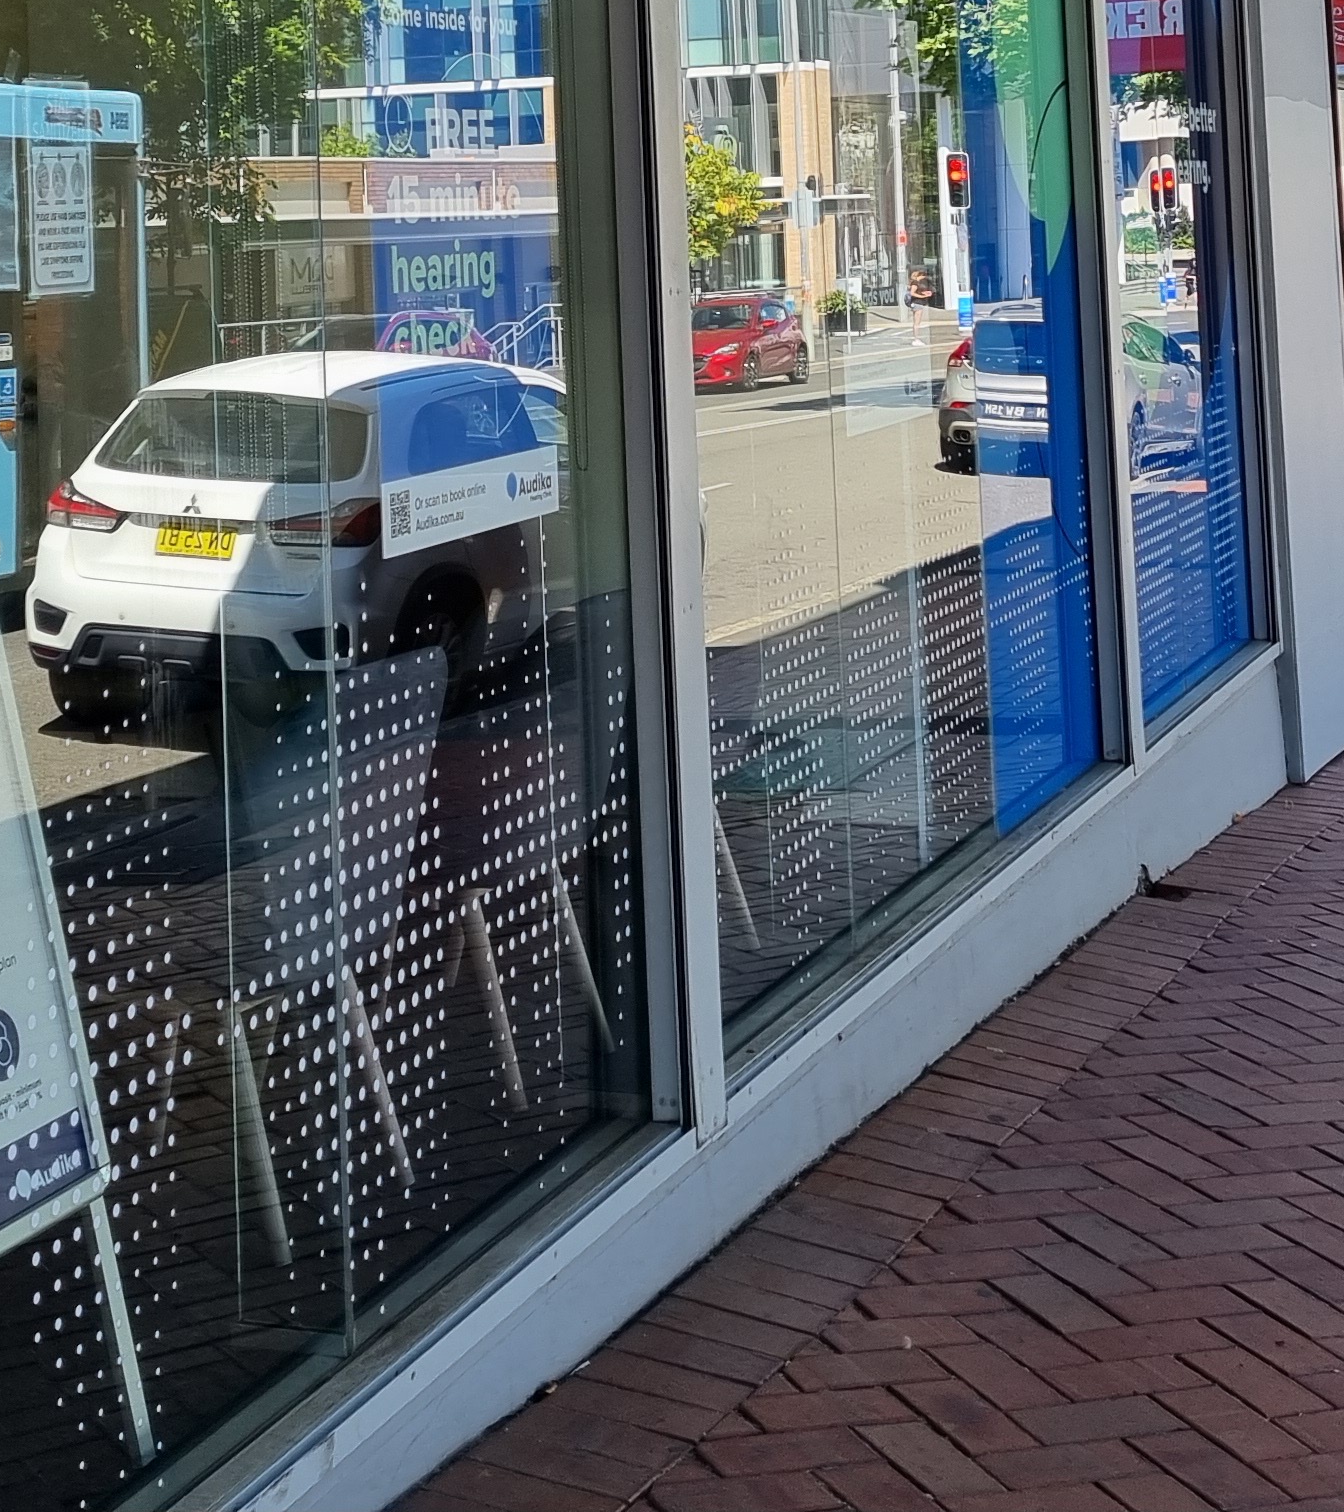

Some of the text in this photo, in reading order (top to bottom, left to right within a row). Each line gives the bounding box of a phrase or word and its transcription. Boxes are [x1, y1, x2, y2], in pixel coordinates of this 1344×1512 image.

[425, 4, 466, 32] inside
[468, 12, 487, 34] for
[491, 18, 518, 37] your
[425, 108, 496, 156] FREE
[1188, 99, 1217, 133] better
[387, 173, 522, 224] 15 minute
[391, 239, 496, 298] hearing
[394, 312, 476, 356] check
[414, 482, 487, 511] Or scan to book online
[518, 471, 552, 497] Audika
[415, 510, 465, 532] Audika.com.au
[30, 1150, 82, 1191] Audika
